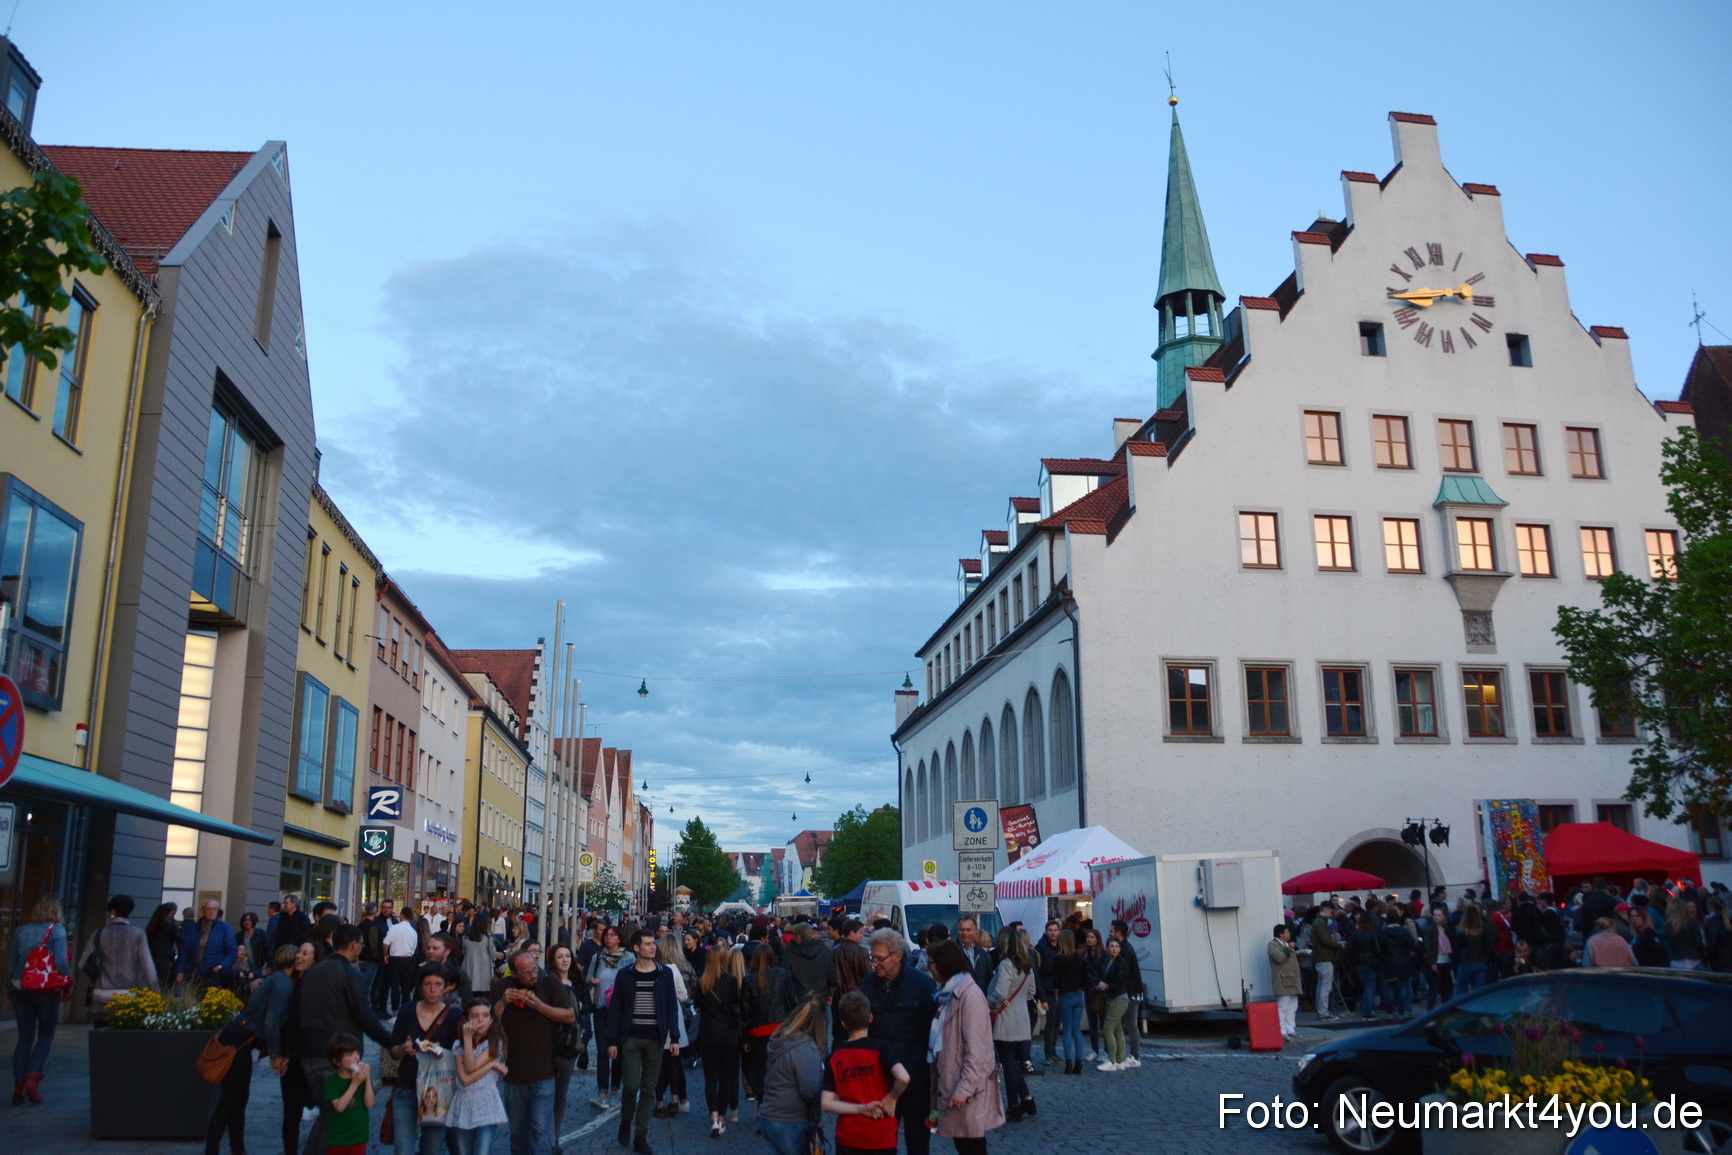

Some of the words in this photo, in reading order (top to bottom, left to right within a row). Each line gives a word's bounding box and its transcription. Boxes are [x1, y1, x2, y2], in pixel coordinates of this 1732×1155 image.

[1389, 263, 1414, 283] X
[964, 837, 988, 846] ZONE
[960, 855, 993, 863] Lieferverkehr
[972, 871, 981, 879] frei
